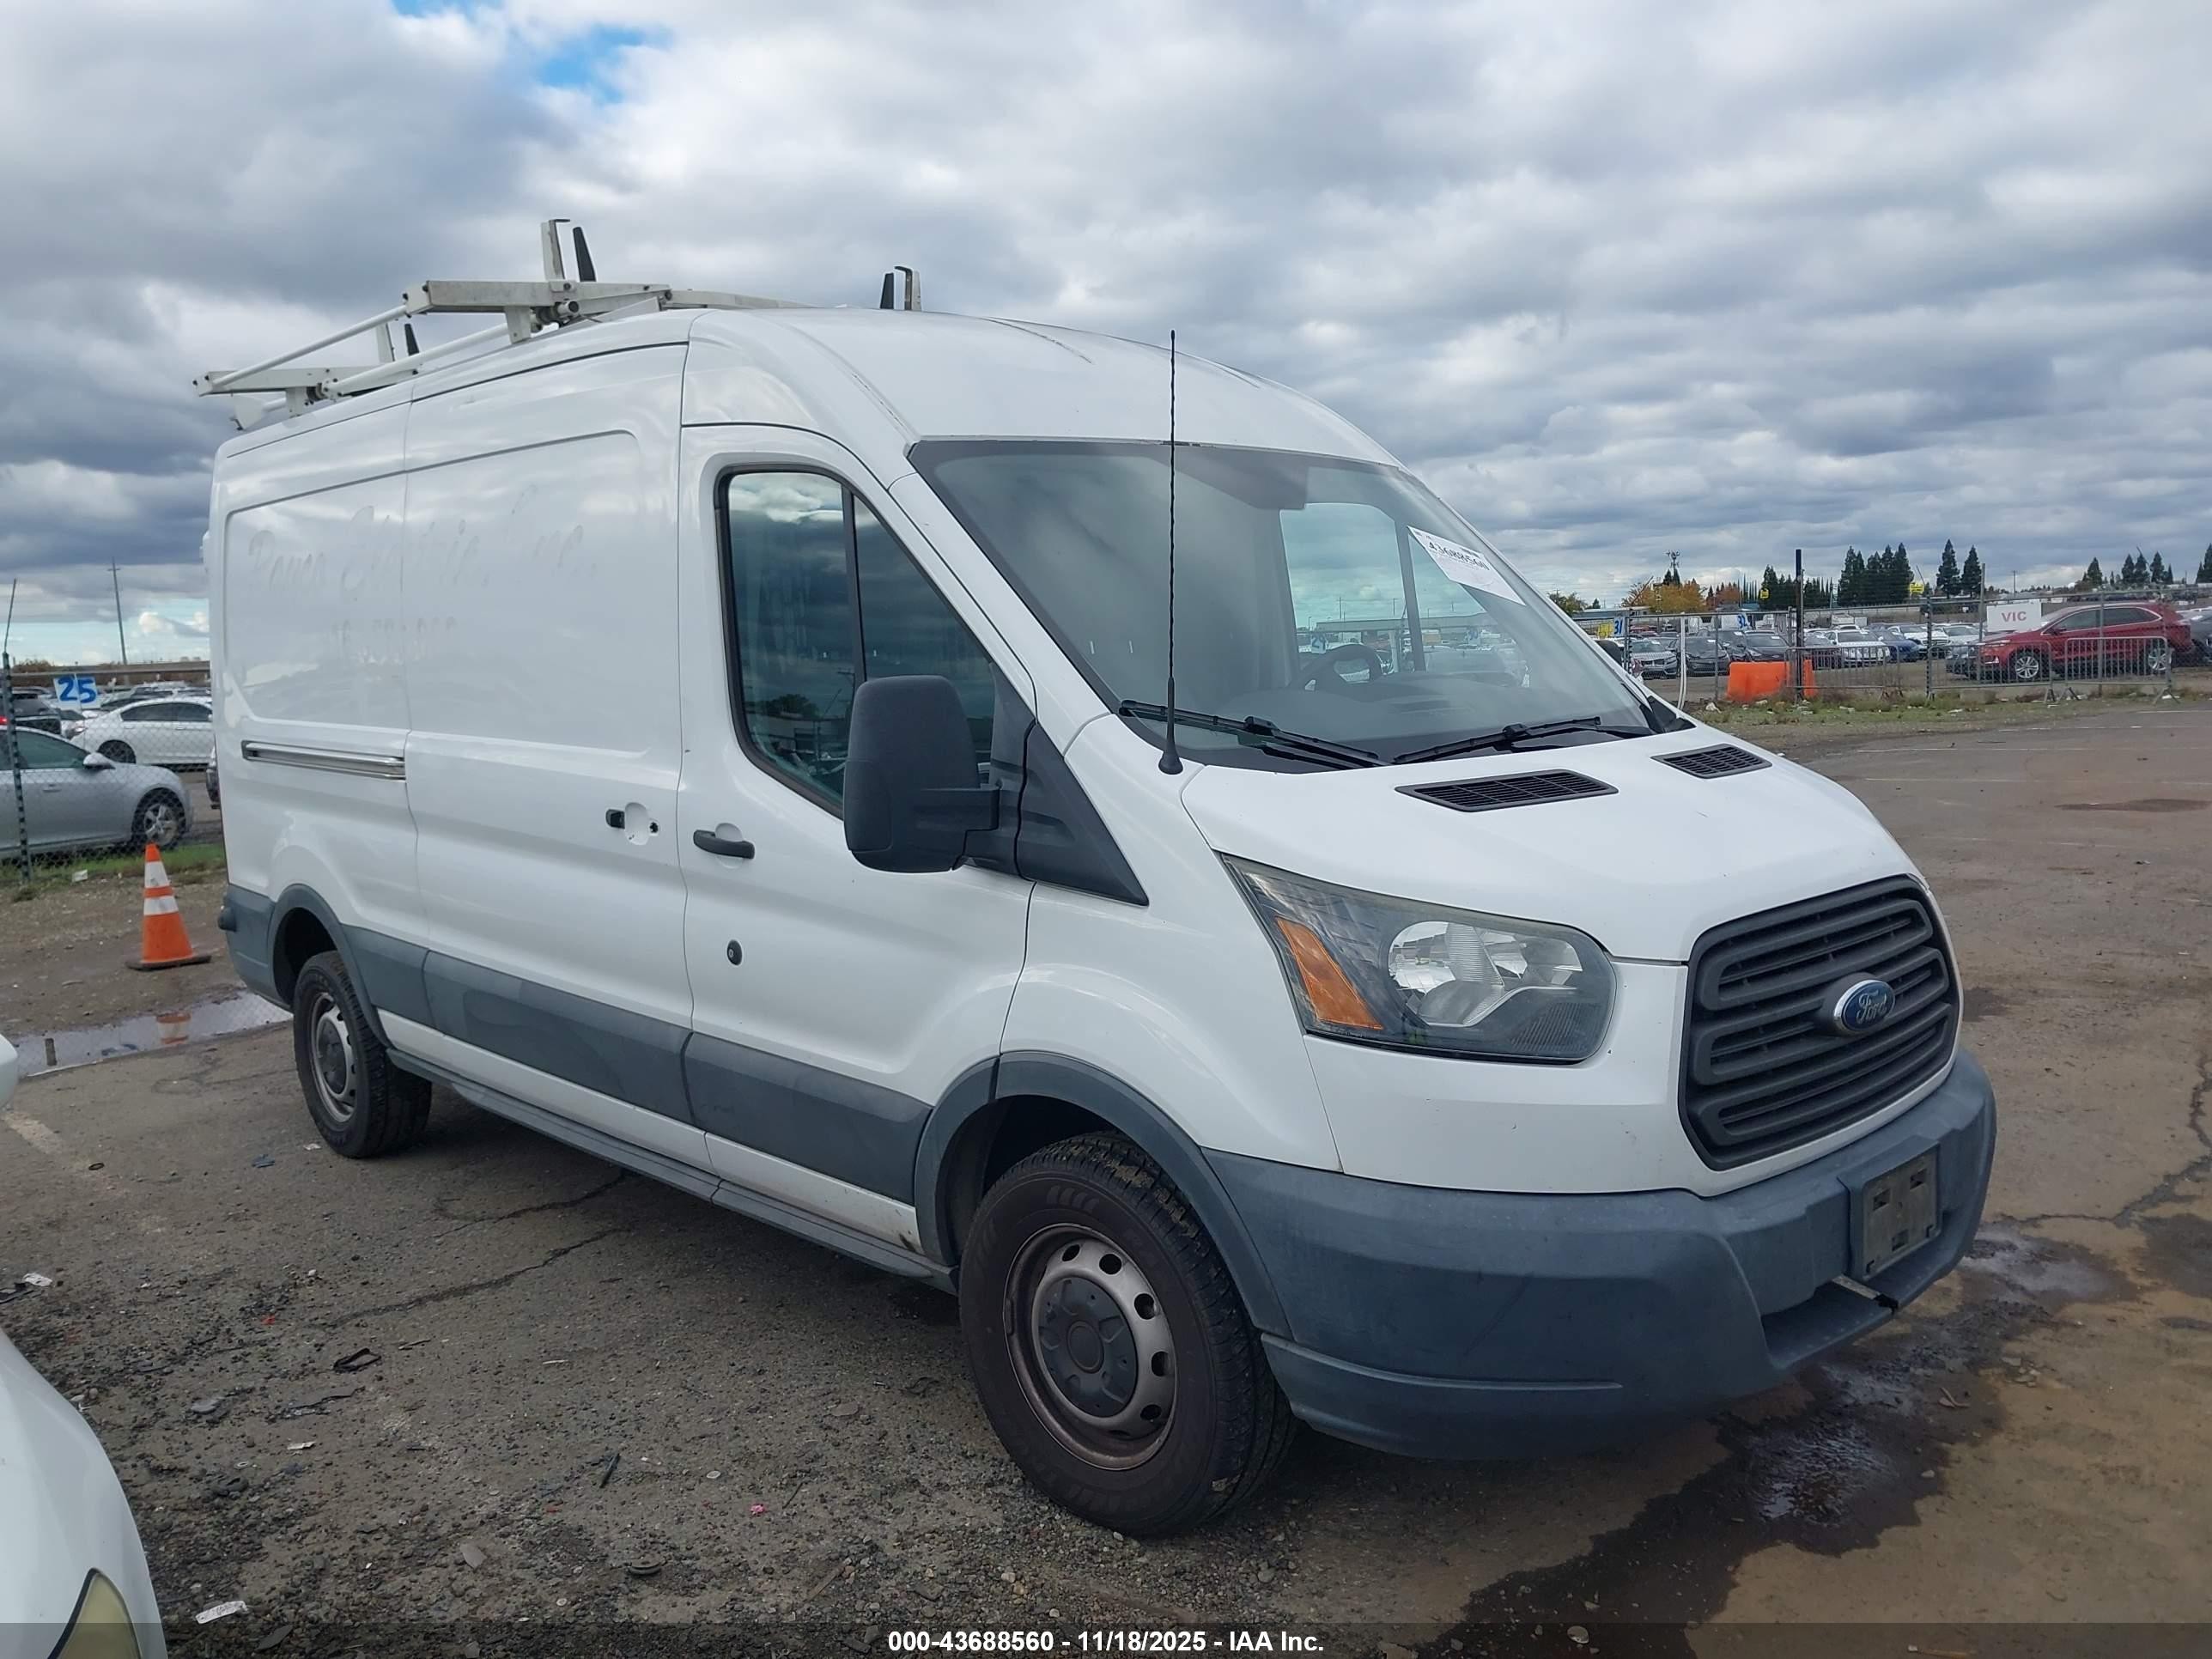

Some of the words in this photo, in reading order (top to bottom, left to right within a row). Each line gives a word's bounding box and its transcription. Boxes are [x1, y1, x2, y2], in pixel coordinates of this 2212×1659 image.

[1614, 619, 1623, 635] 31
[2002, 611, 2027, 623] VIC
[58, 677, 97, 703] 25
[1856, 989, 1887, 1024] Ford
